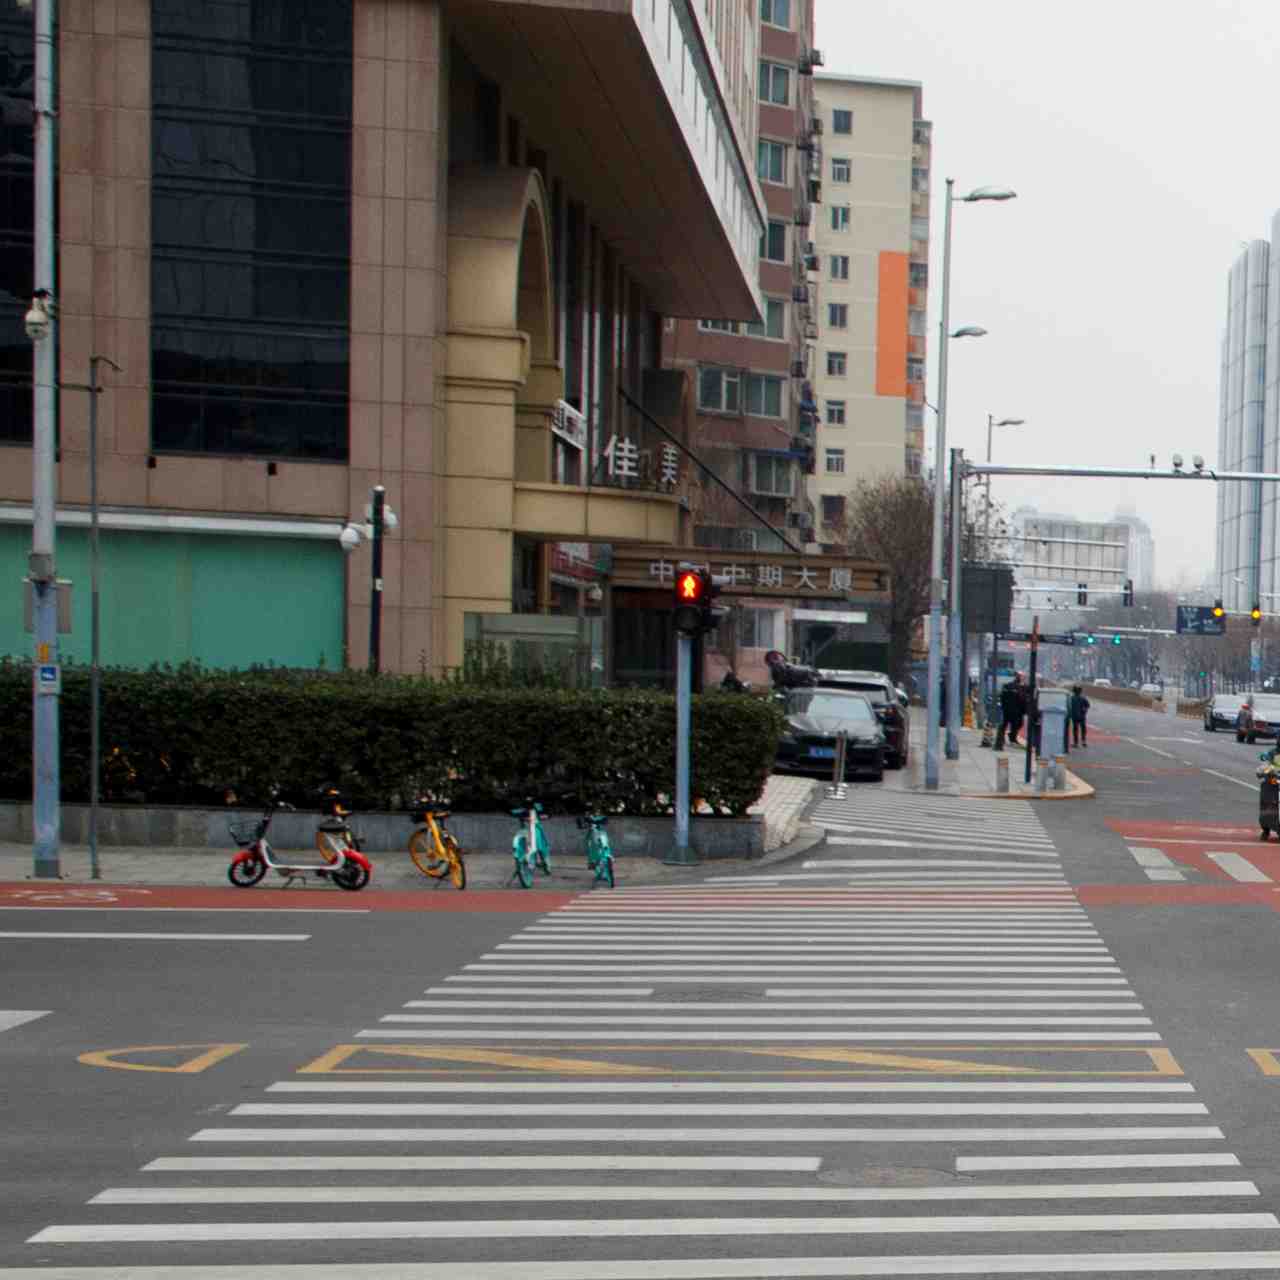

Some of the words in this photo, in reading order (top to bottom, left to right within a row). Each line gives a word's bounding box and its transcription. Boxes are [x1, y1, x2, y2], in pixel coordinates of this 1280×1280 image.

[650, 560, 854, 592] 中中期大厦
